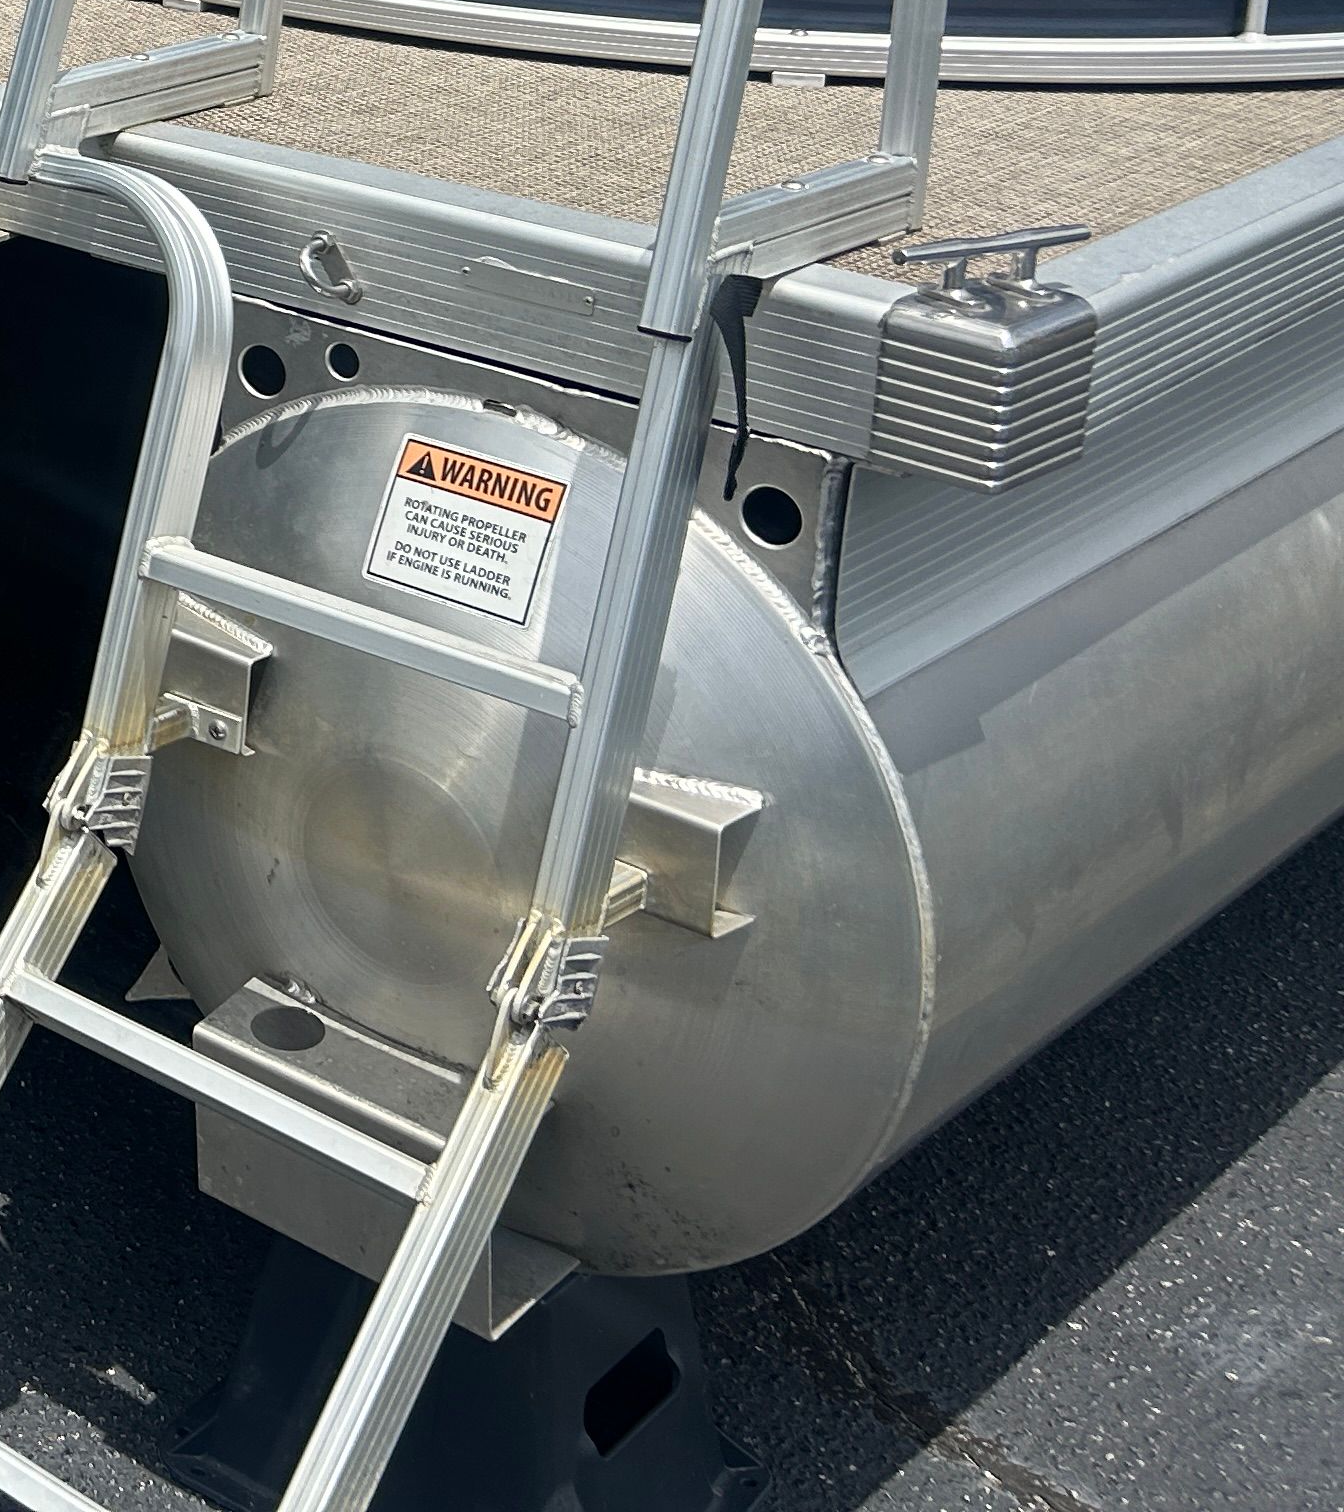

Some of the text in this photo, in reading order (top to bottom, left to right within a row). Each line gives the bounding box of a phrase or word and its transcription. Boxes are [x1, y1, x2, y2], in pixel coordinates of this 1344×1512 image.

[440, 457, 554, 512] WARNING
[404, 496, 528, 544] ROTATING PROPELLER
[405, 510, 519, 554] CAN CAUSE SERIOUS
[406, 523, 508, 564] INJURY OR DEATH.
[386, 550, 511, 600] IF ENGINE IS RUNNING.
[394, 540, 511, 587] DO NOT USE LADDER
